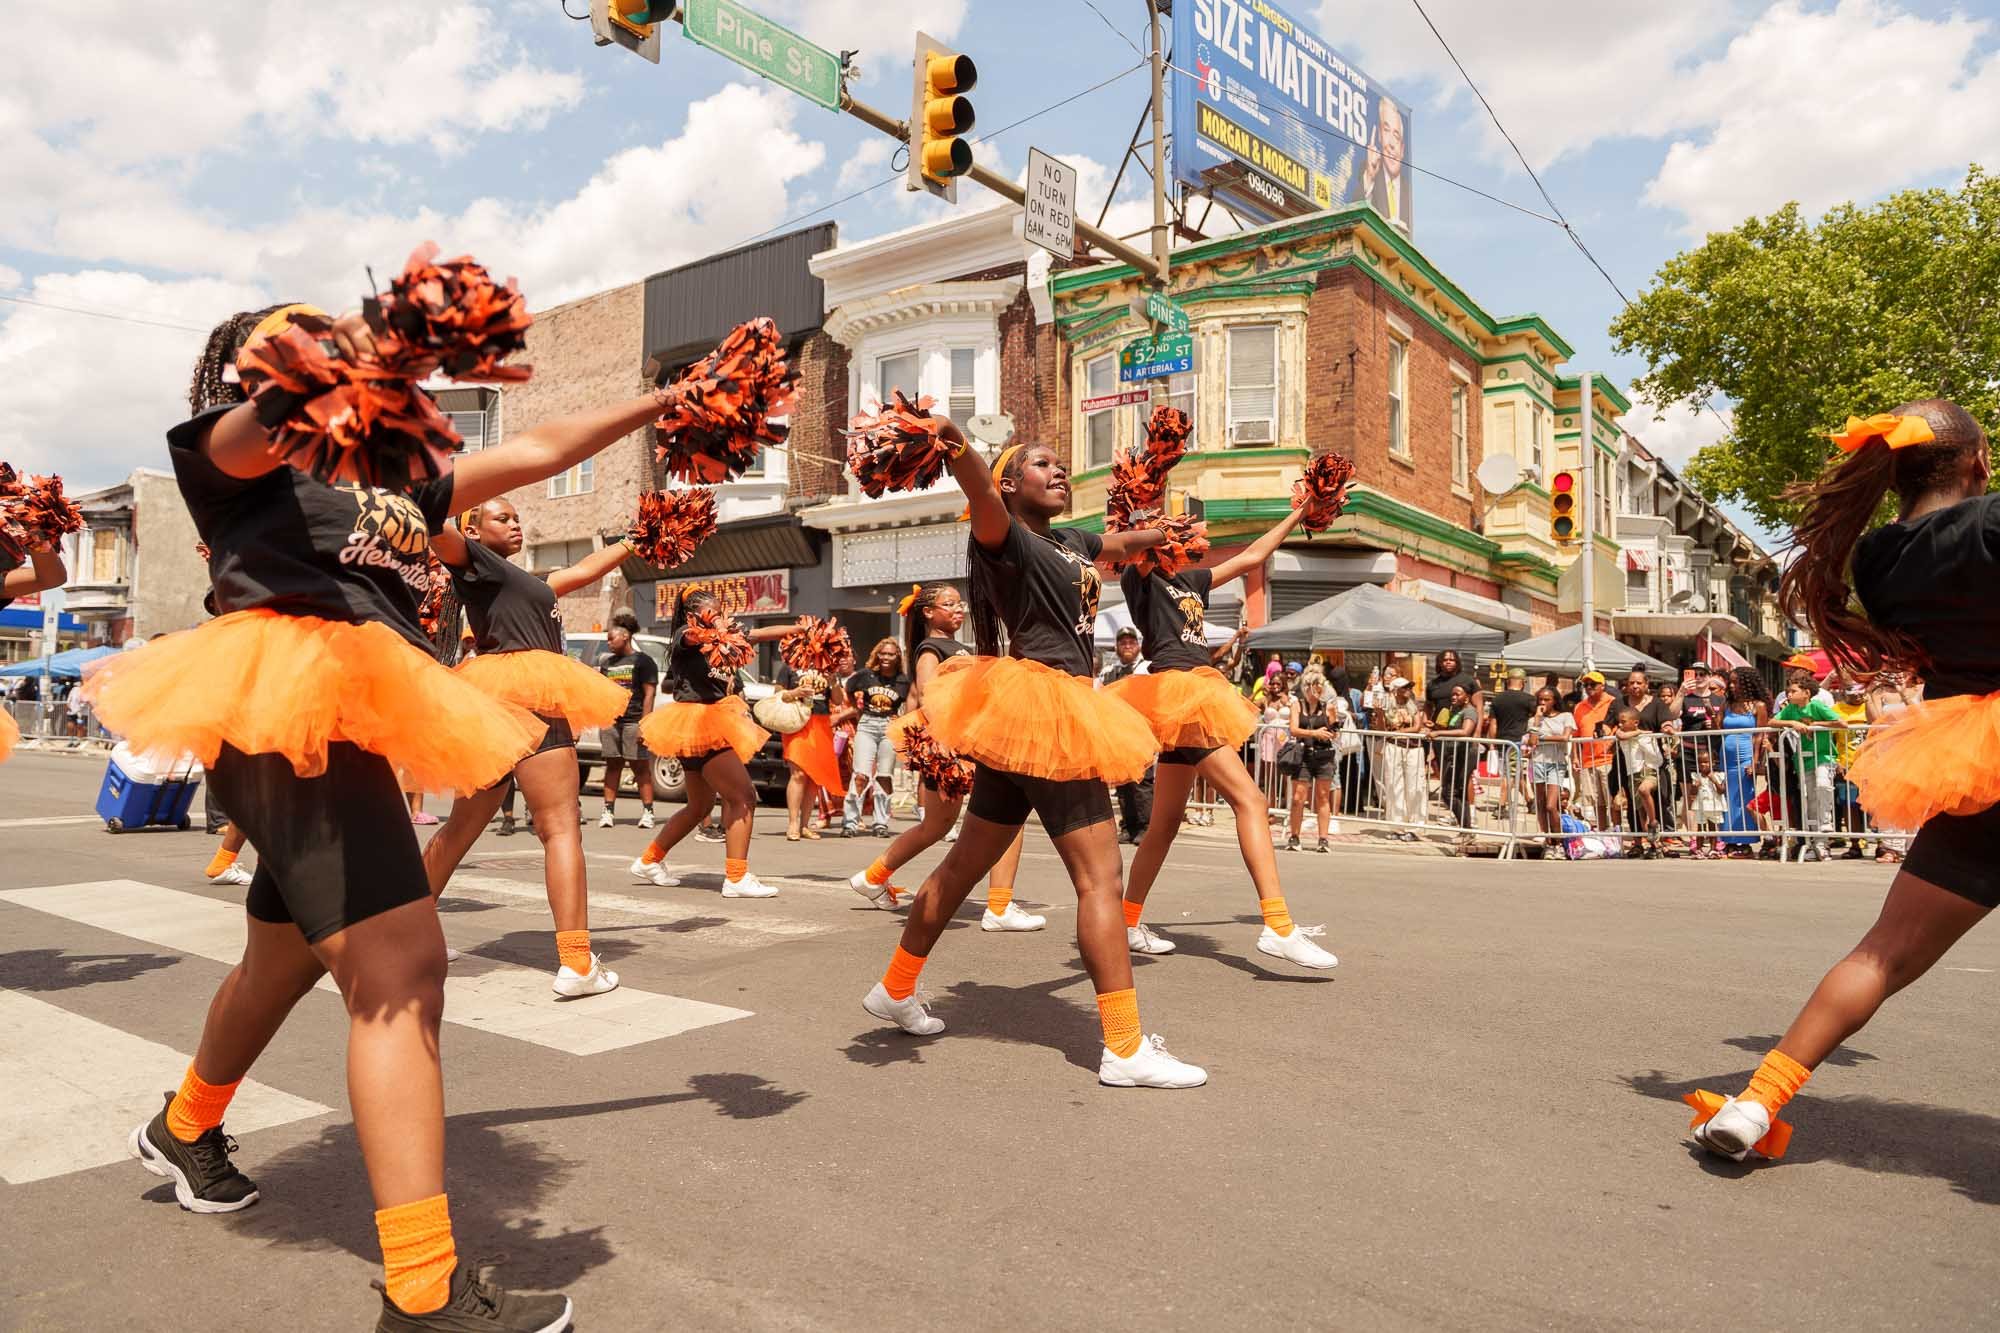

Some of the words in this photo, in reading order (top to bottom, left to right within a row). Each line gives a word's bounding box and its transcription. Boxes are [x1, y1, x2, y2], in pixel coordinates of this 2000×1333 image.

[716, 7, 774, 61] Pine
[785, 46, 814, 83] St
[1252, 0, 1294, 36] LARGEST
[1327, 52, 1346, 77] LAW
[1194, 0, 1254, 71] SIZE
[1259, 20, 1368, 147] MATTERS
[1202, 107, 1251, 159] MORGAN
[1251, 138, 1261, 165] &
[1262, 143, 1306, 192] MORGAN
[1043, 162, 1062, 184] NO
[1038, 180, 1066, 208] TURN
[1247, 171, 1285, 207] 094096
[1030, 198, 1045, 217] ON
[1049, 208, 1070, 229] RED
[1027, 219, 1044, 239] 6AM
[1055, 232, 1071, 248] 6PM
[1150, 300, 1175, 327] PINE
[1178, 319, 1187, 331] ST
[1175, 344, 1192, 357] ST
[1123, 369, 1132, 379] N
[1135, 362, 1175, 378] ARTERIAL
[1180, 358, 1189, 370] S
[1082, 396, 1120, 410] Muhammad
[1121, 394, 1132, 404] Ali
